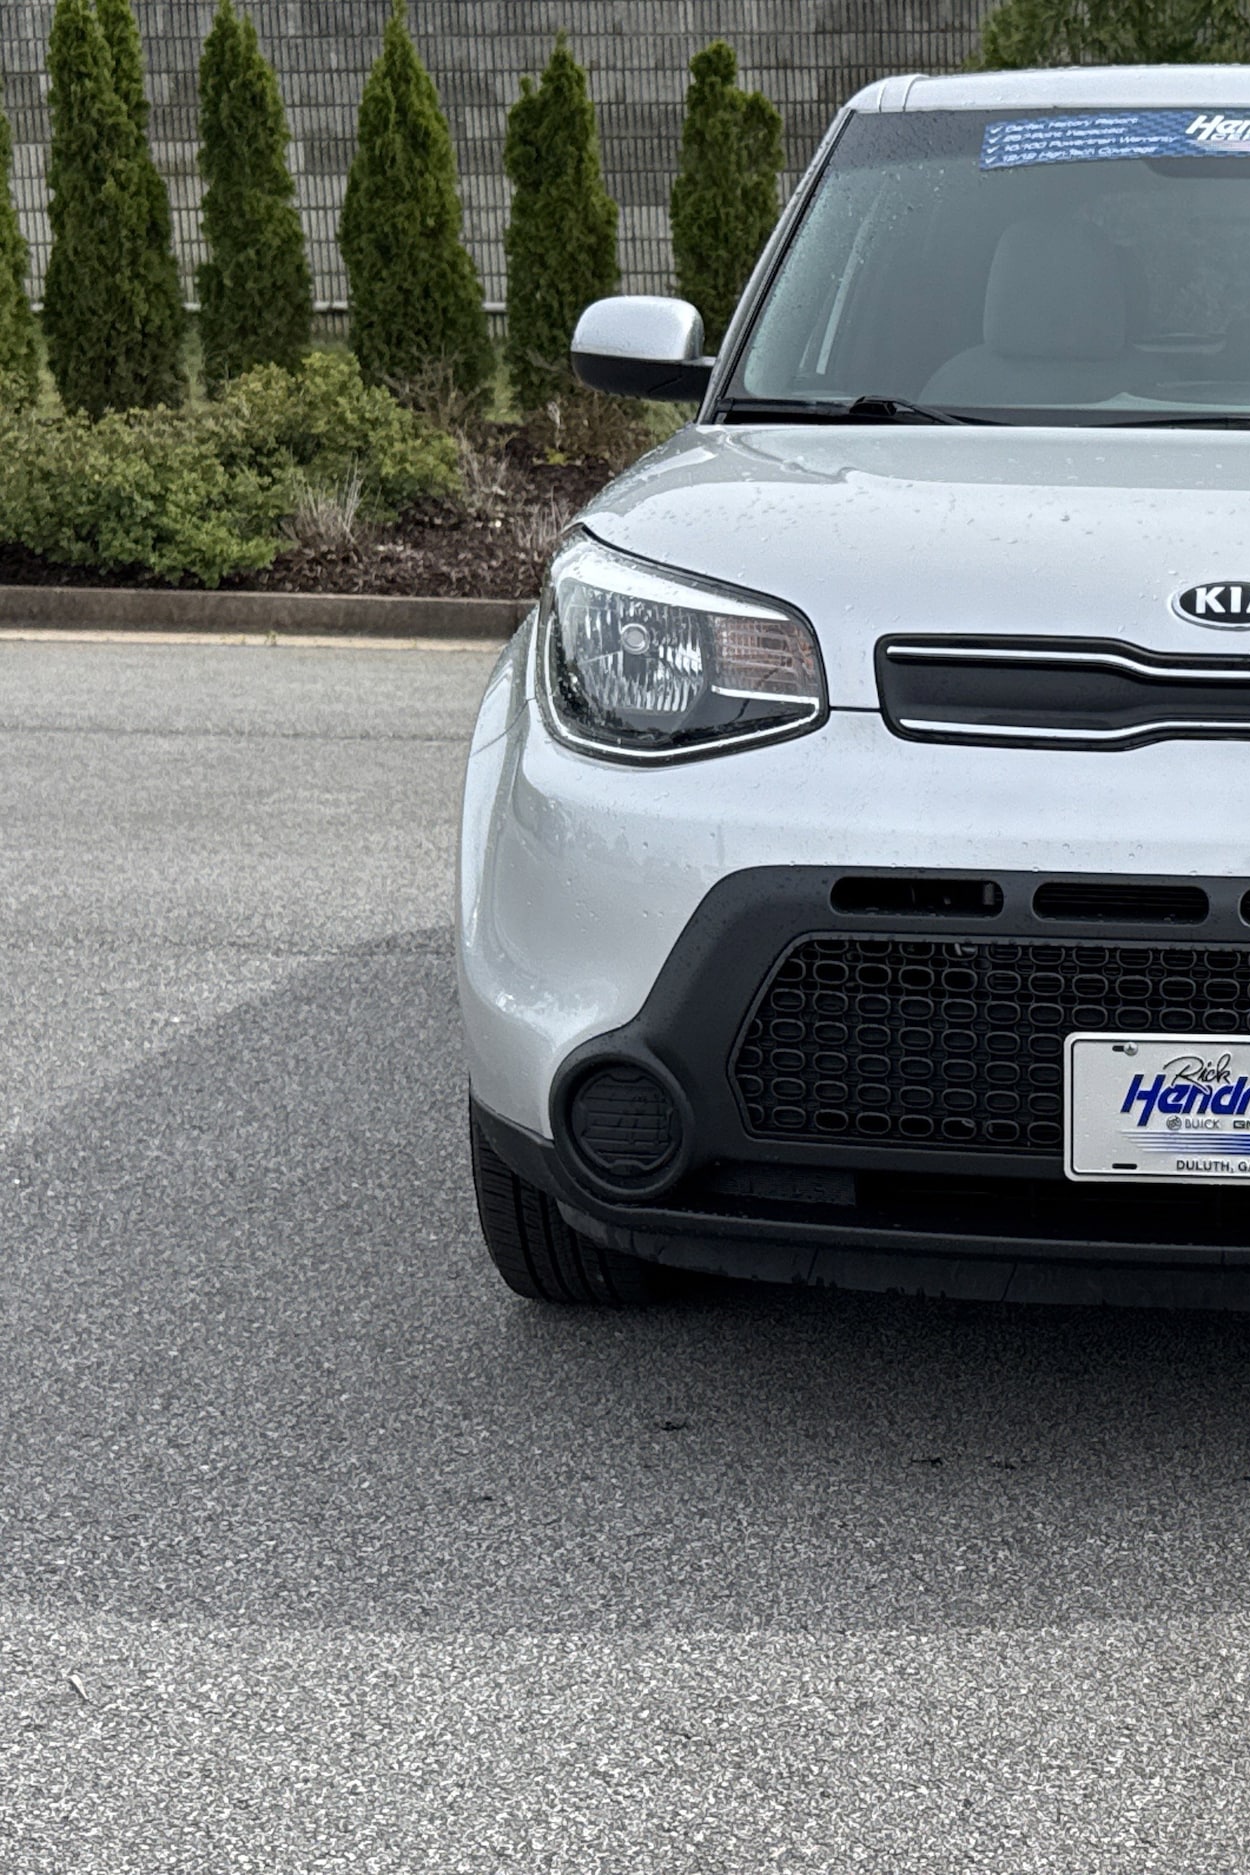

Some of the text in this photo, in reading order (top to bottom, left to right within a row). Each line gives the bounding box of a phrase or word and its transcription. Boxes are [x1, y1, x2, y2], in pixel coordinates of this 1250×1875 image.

[1163, 1053, 1232, 1092] Rick
[1184, 1119, 1220, 1130] BUICK
[1176, 1160, 1234, 1174] DULUTH,
